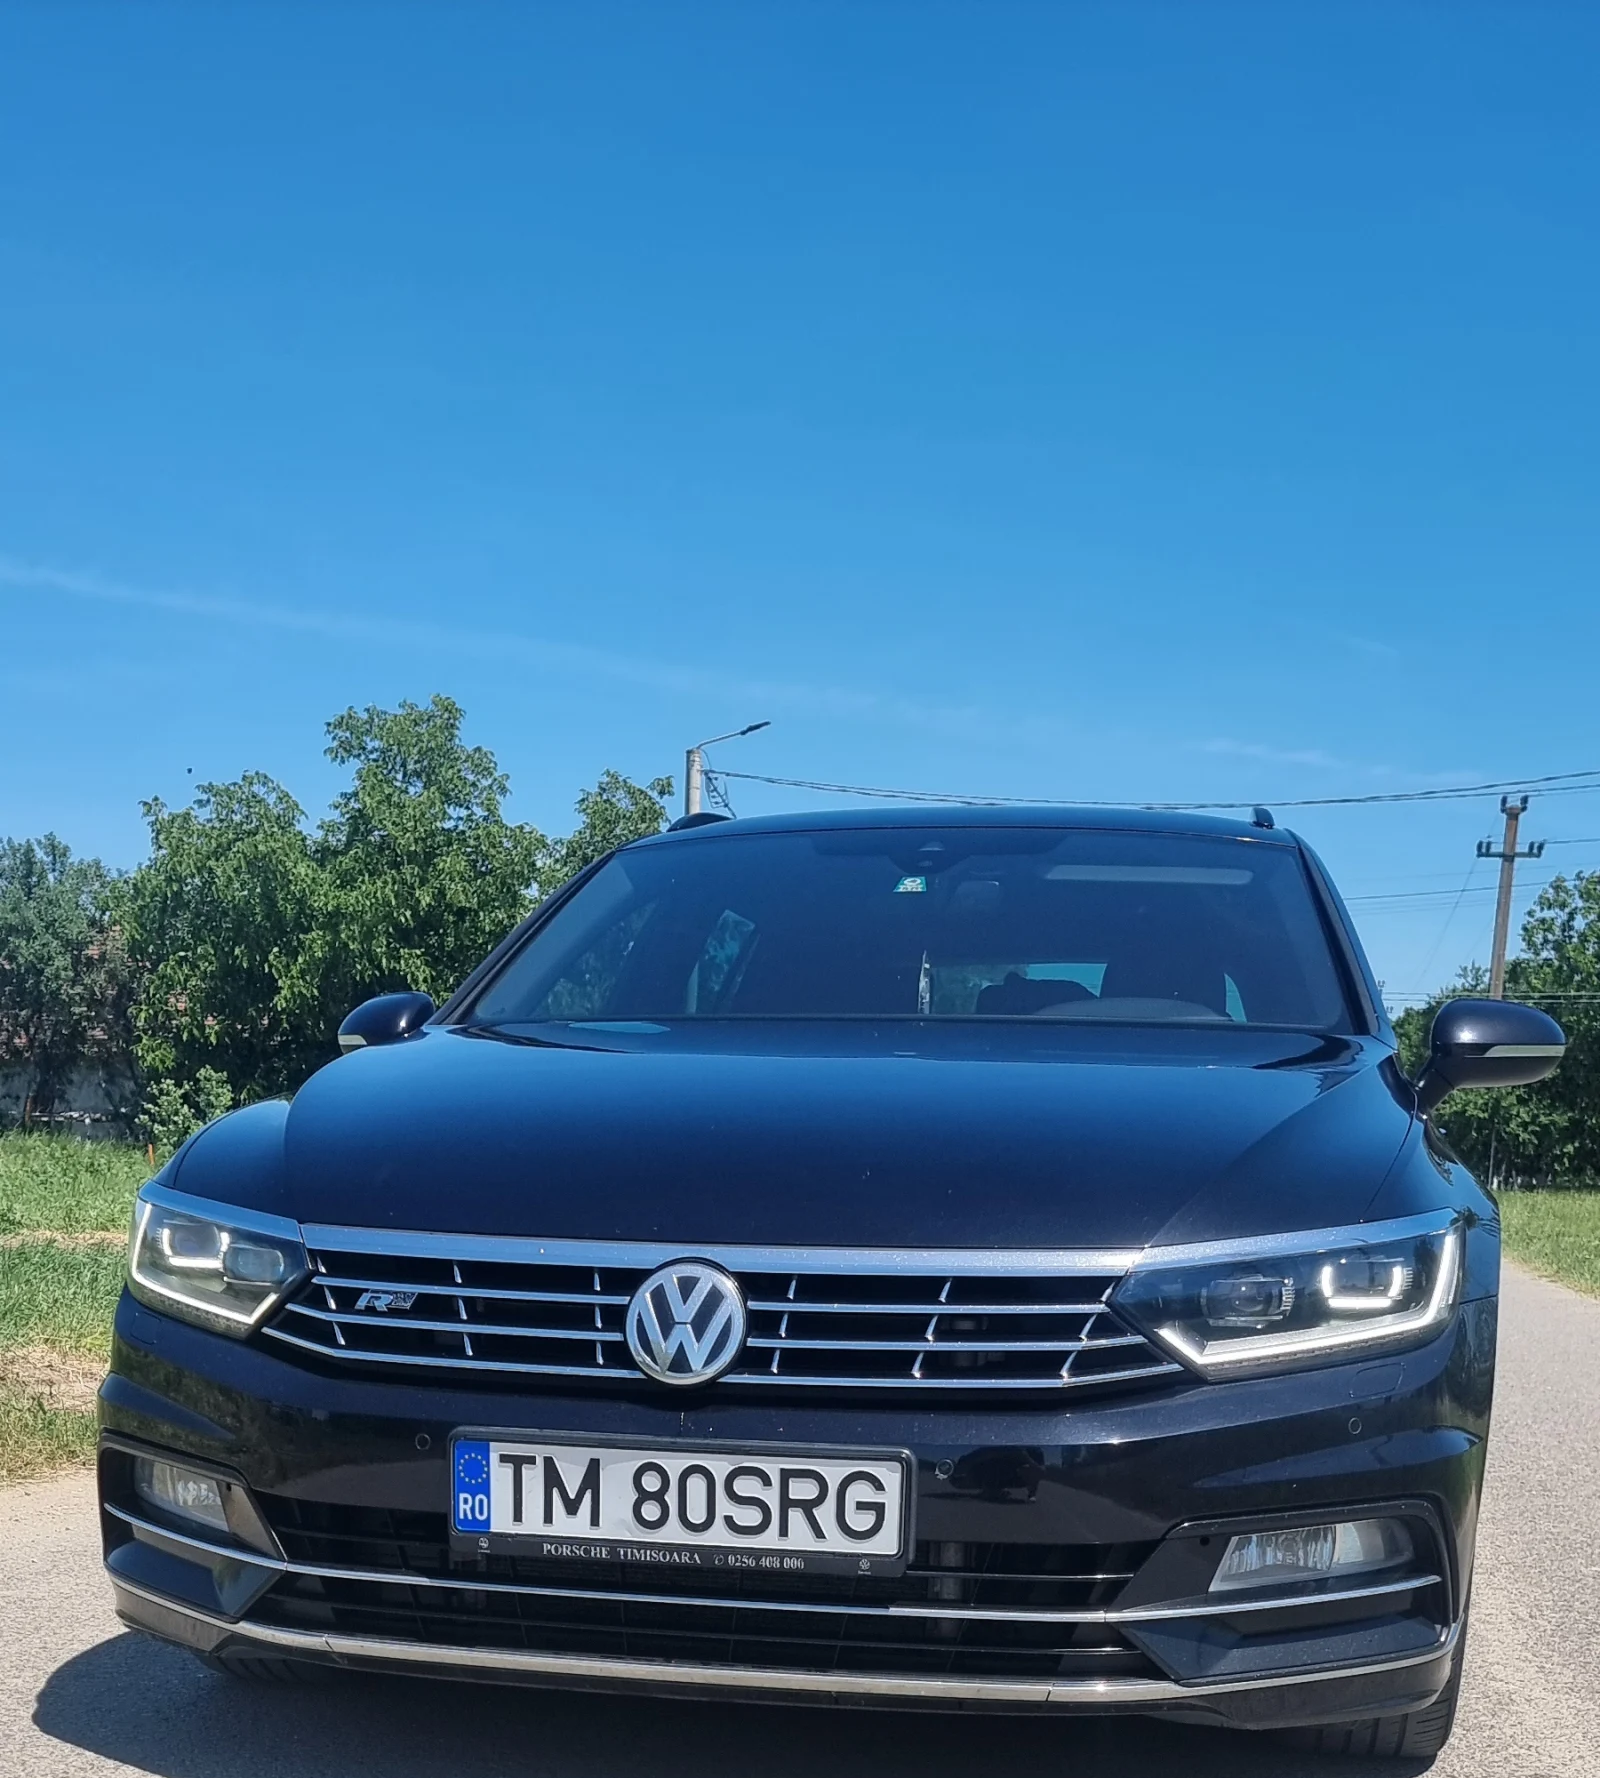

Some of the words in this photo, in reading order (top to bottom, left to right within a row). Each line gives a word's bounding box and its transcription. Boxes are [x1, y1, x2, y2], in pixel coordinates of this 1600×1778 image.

[630, 1266, 740, 1380] VW
[459, 1493, 488, 1521] RO
[499, 1453, 600, 1527] TM
[632, 1461, 887, 1541] 80SRG
[543, 1542, 610, 1559] PORSCHE
[617, 1547, 701, 1564] TIMISOARA
[728, 1554, 756, 1567] 0256
[759, 1556, 780, 1569] 408
